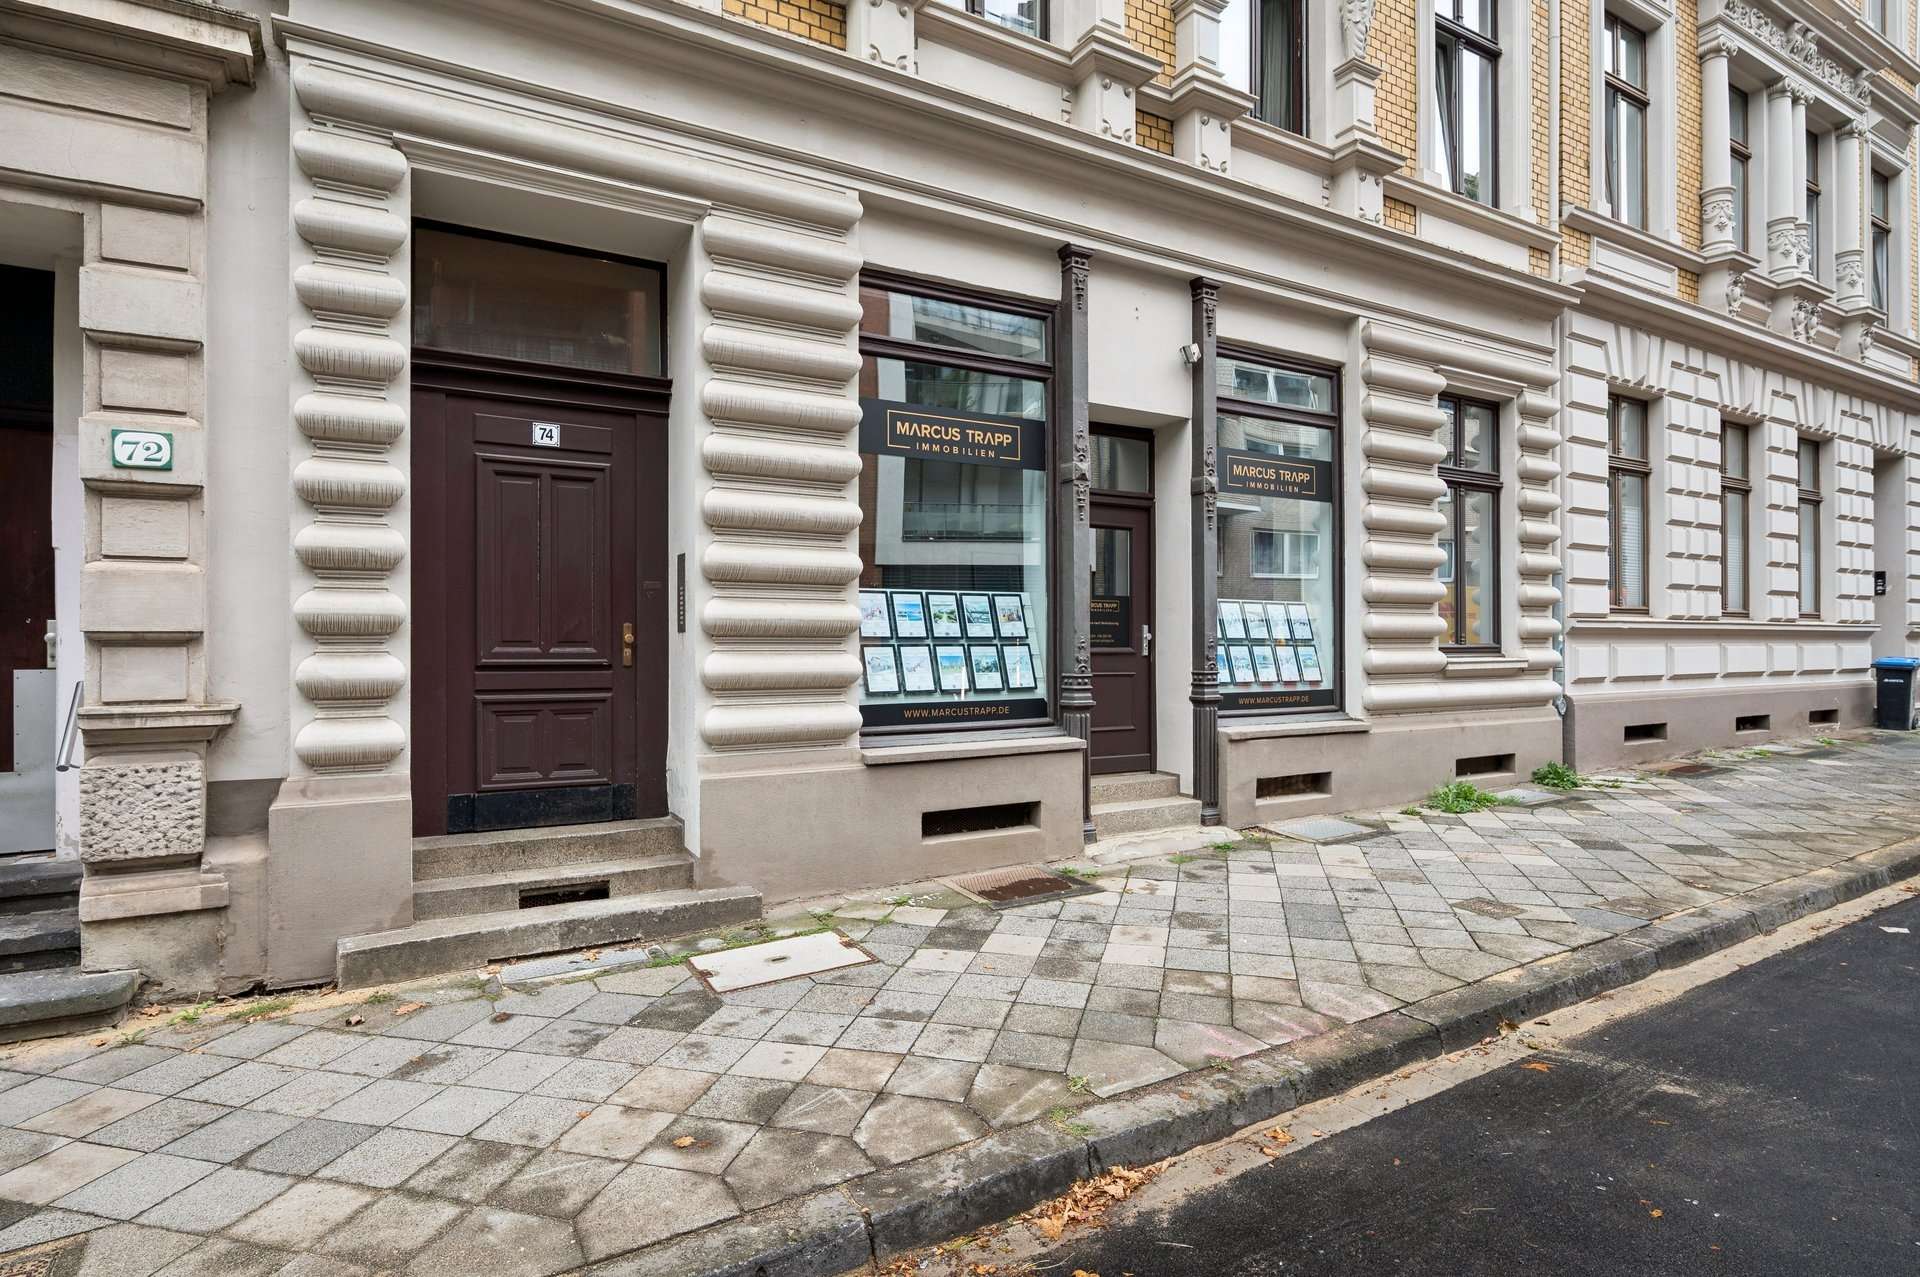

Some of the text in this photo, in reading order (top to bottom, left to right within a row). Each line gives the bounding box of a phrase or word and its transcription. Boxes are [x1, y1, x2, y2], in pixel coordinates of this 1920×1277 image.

[539, 428, 554, 441] 74
[896, 421, 1013, 447] MARCUS TRAPP
[121, 440, 163, 462] 72
[916, 442, 995, 458] IMMOBILIEN
[1233, 464, 1310, 483] MARCUS TRAPP
[1246, 481, 1299, 493] IMMOBILIEN
[1239, 696, 1308, 704] WWW.MARCUSTRAPP.DE
[904, 706, 1010, 718] WWW.MARCUSTRAPP.DE
